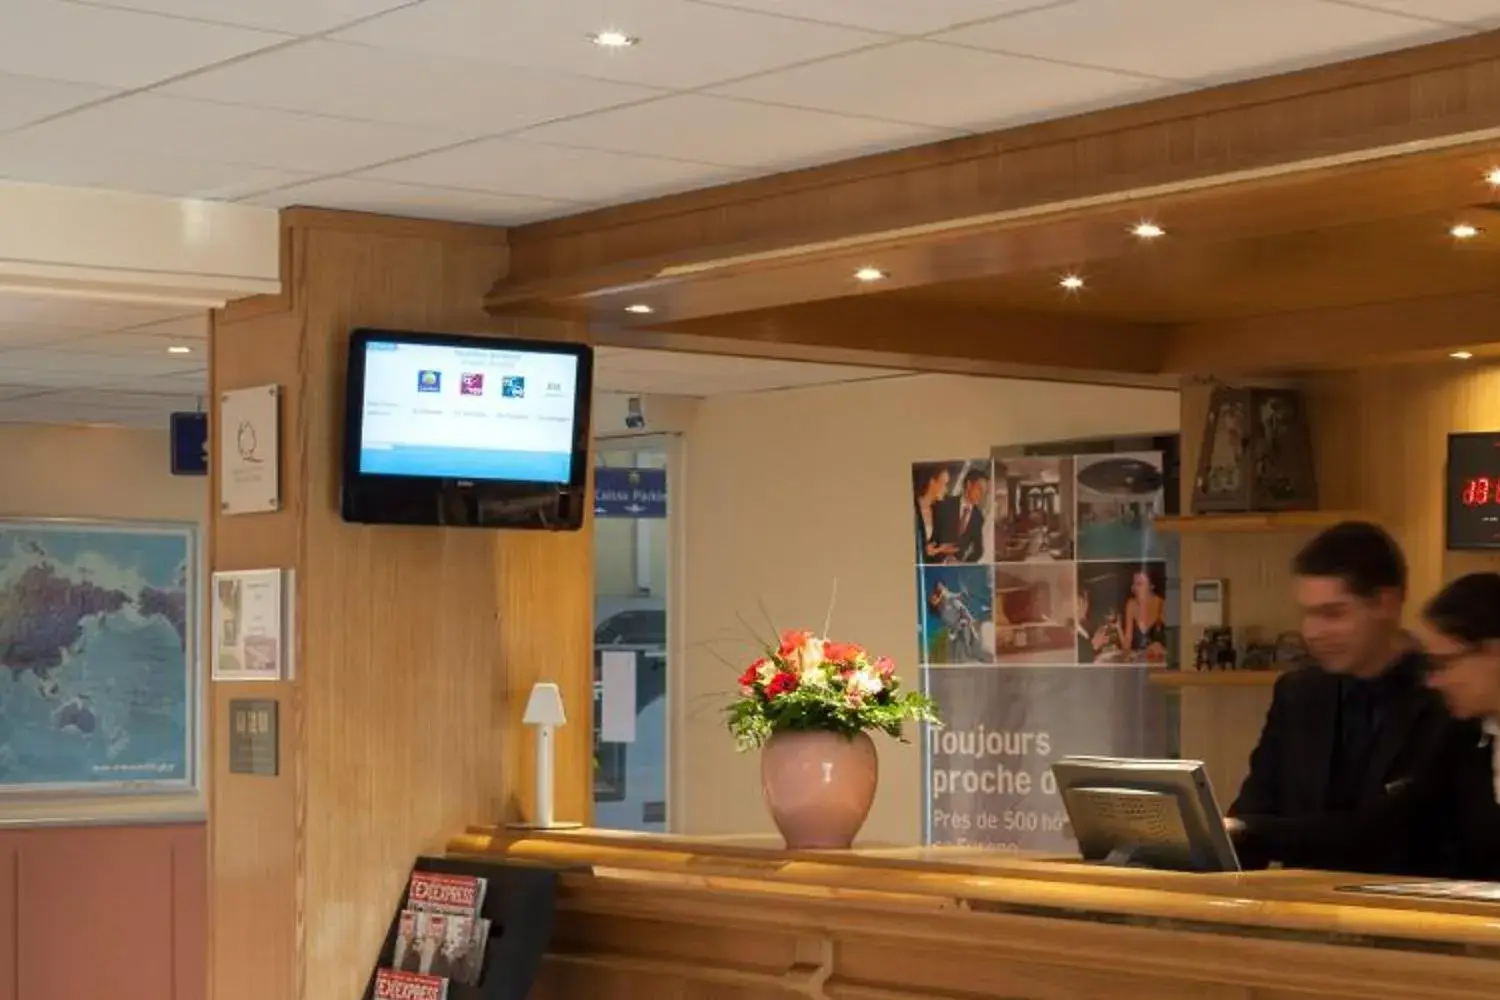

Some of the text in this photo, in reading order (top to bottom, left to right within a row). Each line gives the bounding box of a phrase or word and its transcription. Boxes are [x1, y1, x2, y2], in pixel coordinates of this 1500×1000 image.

[933, 724, 1051, 759] Toujours
[933, 764, 1032, 799] proche
[933, 808, 971, 829] Près
[977, 810, 998, 829] de
[1004, 810, 1038, 832] 500
